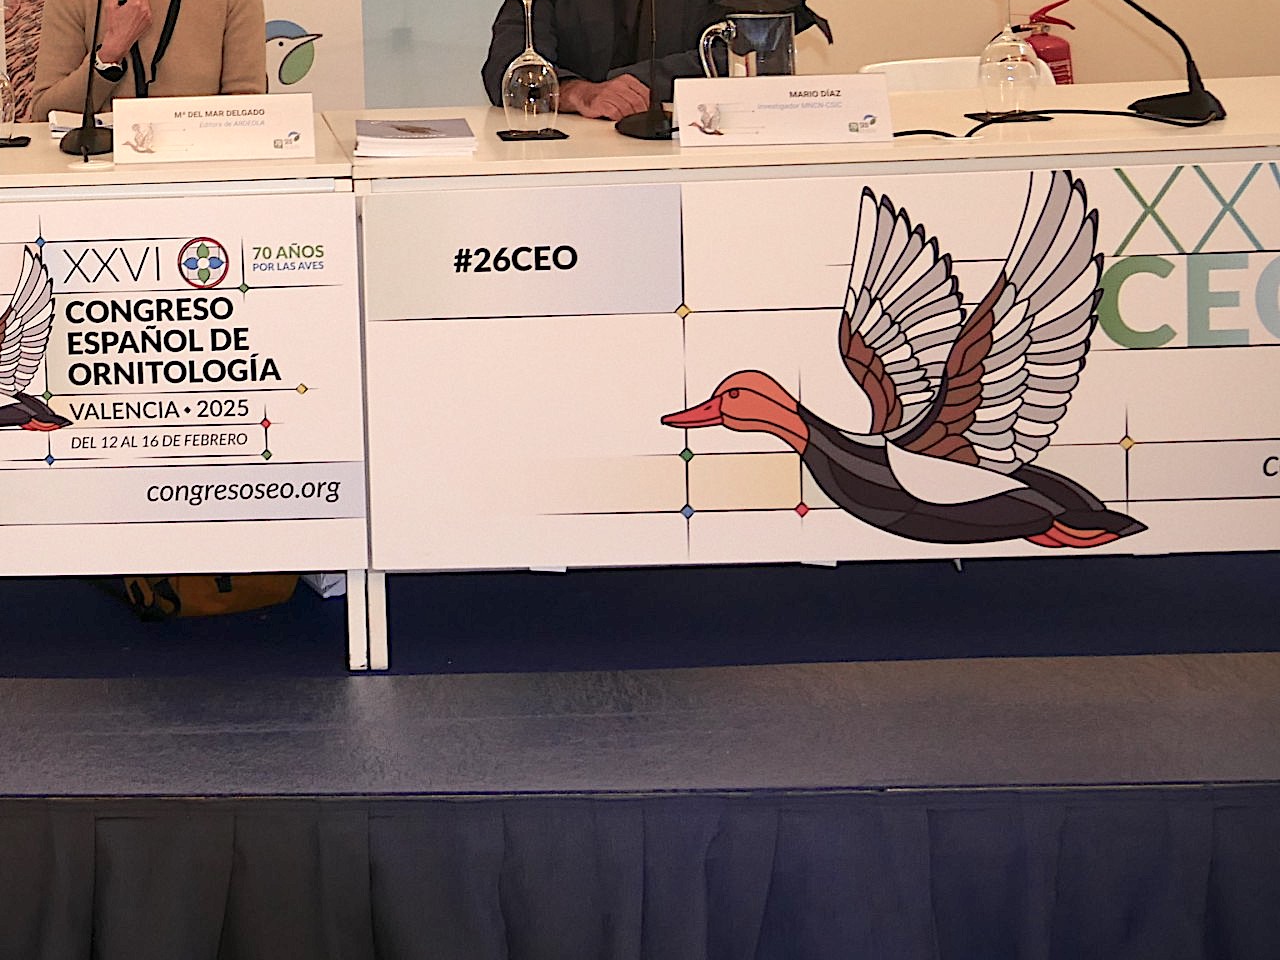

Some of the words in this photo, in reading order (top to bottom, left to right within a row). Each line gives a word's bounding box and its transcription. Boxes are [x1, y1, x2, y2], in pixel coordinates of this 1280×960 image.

[789, 90, 818, 98] MARIO
[820, 88, 841, 97] DÍAZ
[226, 109, 265, 117] DELGADO
[1113, 162, 1280, 257] XX
[63, 246, 161, 284] XXVI
[252, 246, 272, 260] 70
[276, 243, 324, 259] AÑOS
[453, 244, 578, 274] #26CEO
[252, 262, 272, 272] POR
[276, 262, 295, 271] LAS
[297, 261, 324, 271] AVES
[65, 296, 234, 324] CONGRESO
[1096, 253, 1280, 349] CE
[67, 325, 204, 355] ESPAÑOL
[211, 327, 249, 351] DE
[68, 353, 282, 386] ORNITOLOGÍA
[69, 400, 180, 420] VALENCIA
[197, 399, 249, 418] 2025
[71, 436, 97, 449] DEL
[102, 436, 118, 449] 12
[120, 435, 138, 448] AL
[143, 435, 159, 448] 16
[162, 434, 180, 447] DE
[184, 432, 248, 447] FEBRERO
[147, 480, 341, 506] congresoseo.org
